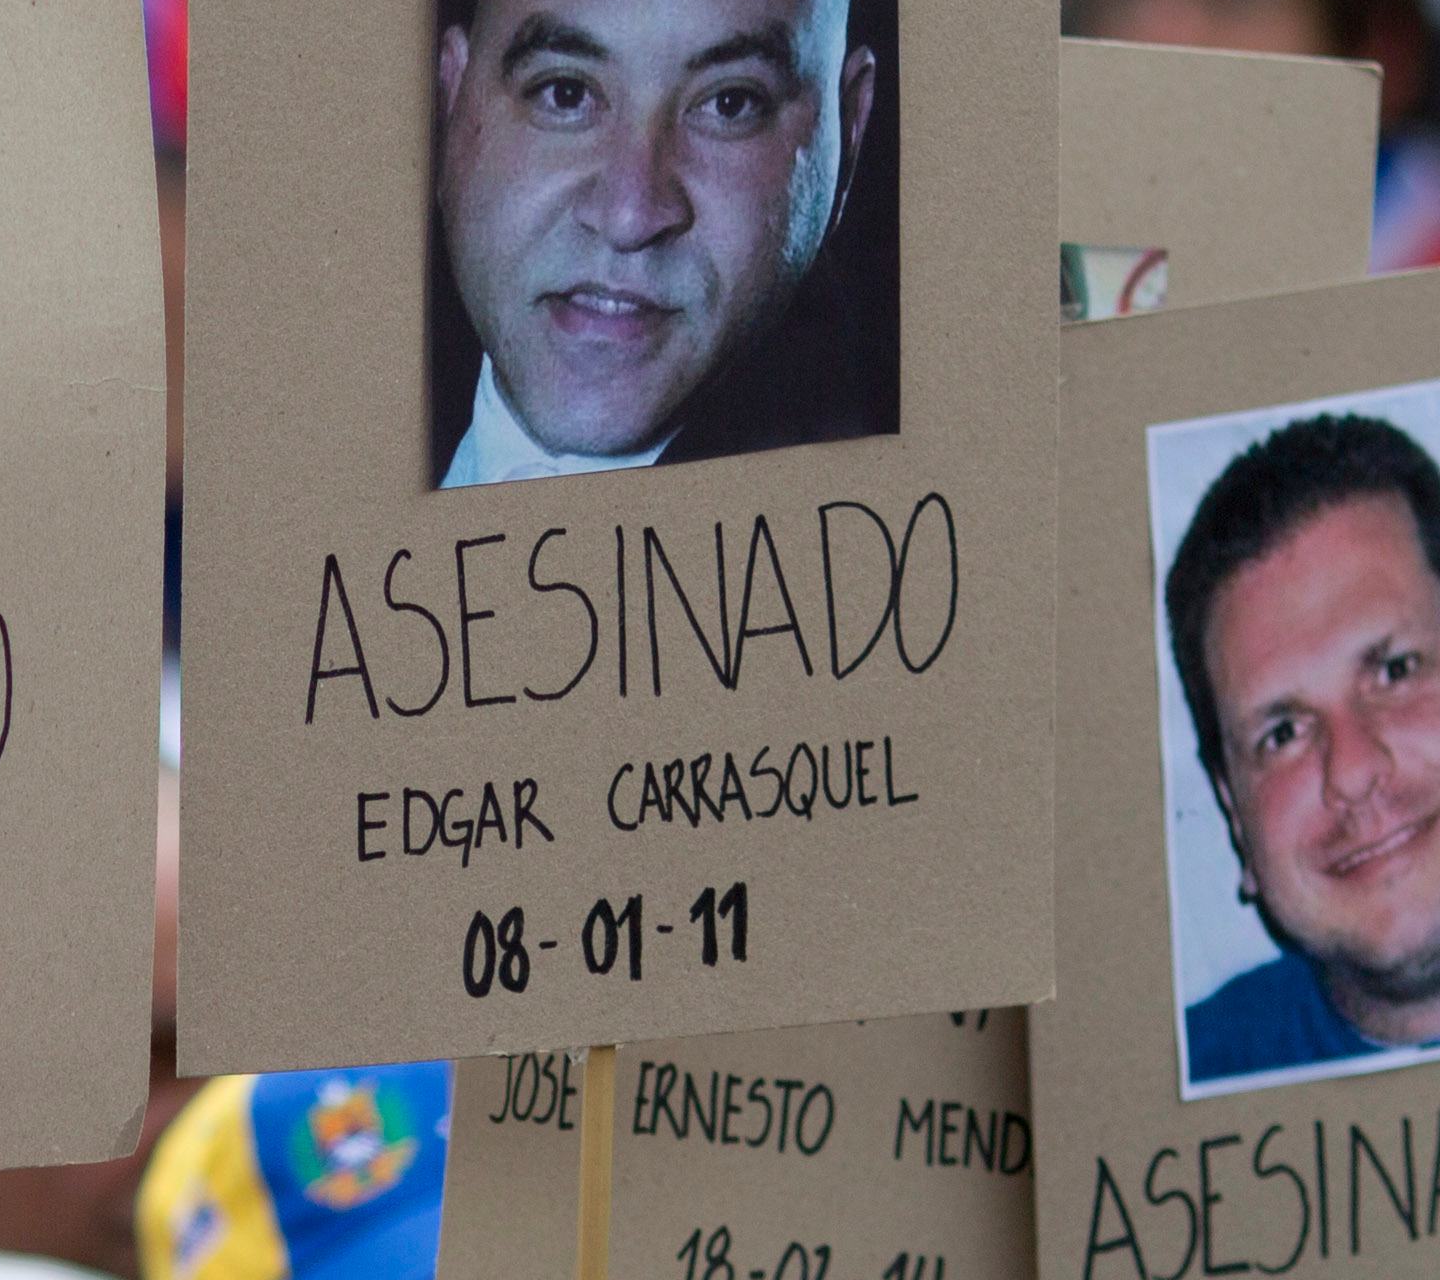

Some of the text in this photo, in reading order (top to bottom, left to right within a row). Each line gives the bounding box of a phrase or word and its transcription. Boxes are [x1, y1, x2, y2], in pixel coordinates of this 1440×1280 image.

[305, 491, 960, 725] ASESINADO
[356, 735, 919, 868] EDGAR CARRASQUEL
[488, 1052, 1035, 1177] JOSE ERNESTO MEND
